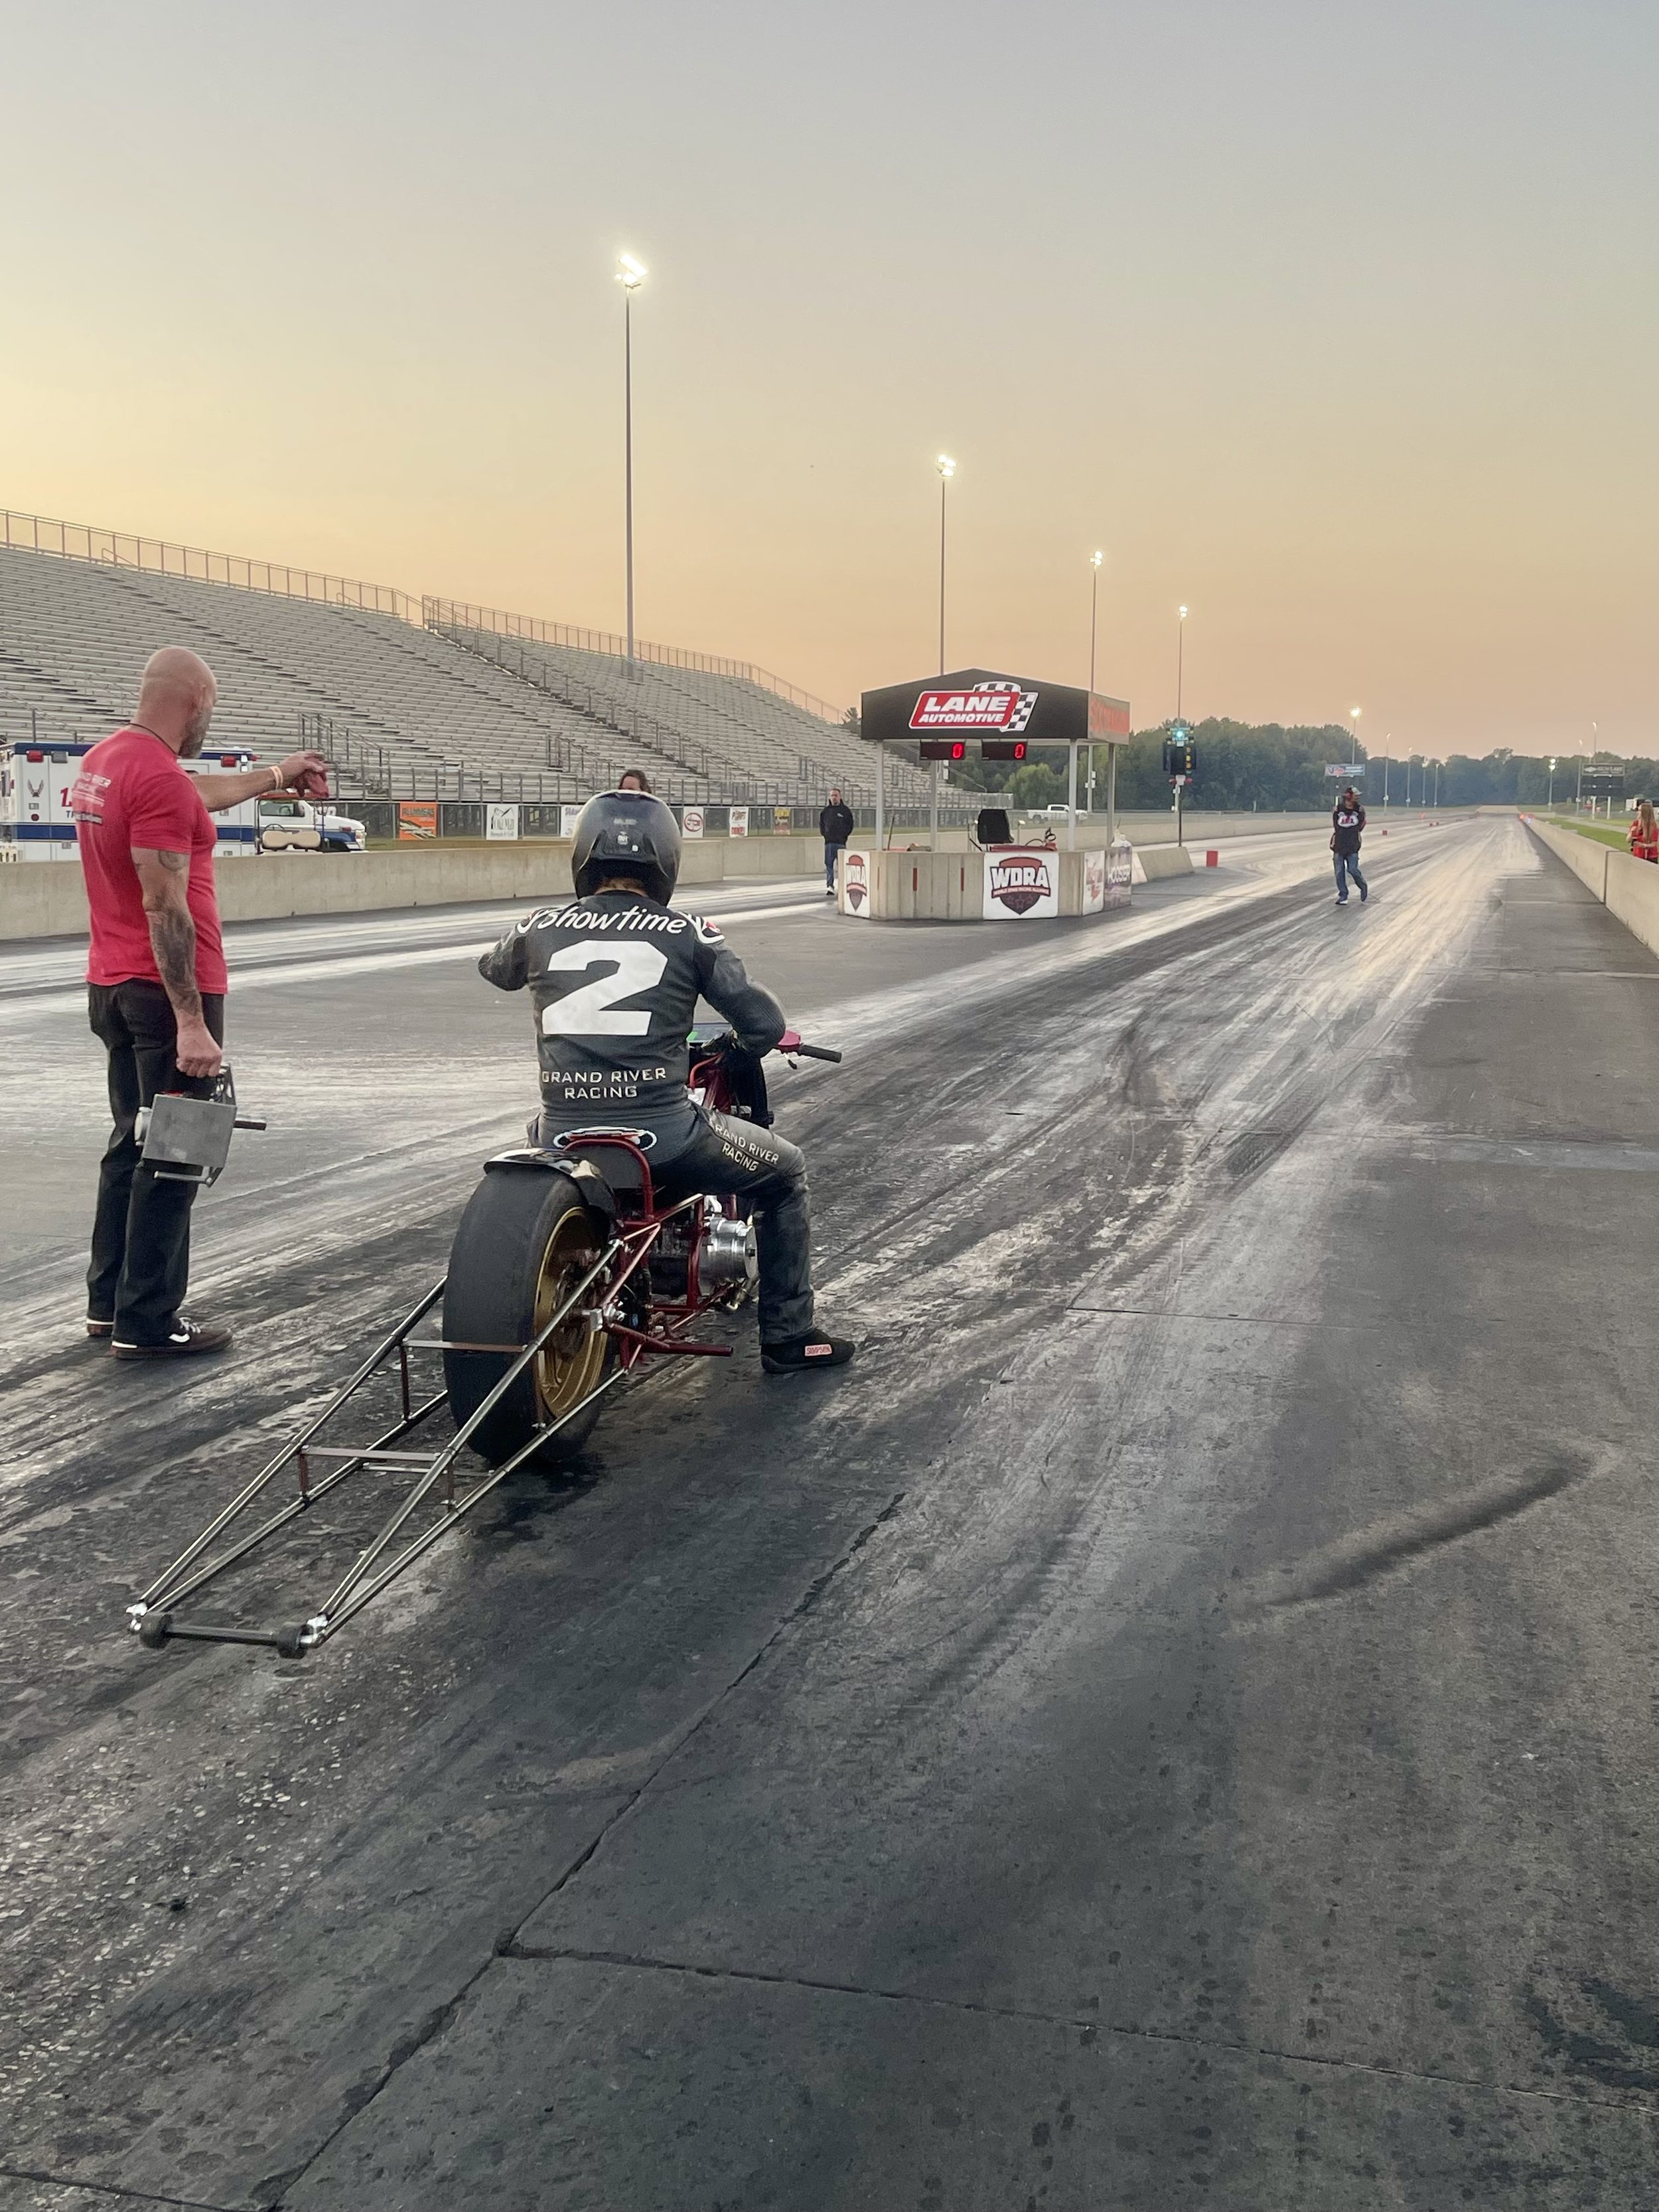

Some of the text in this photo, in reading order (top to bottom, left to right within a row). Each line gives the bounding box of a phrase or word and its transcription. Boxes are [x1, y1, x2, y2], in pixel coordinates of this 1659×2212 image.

[924, 696, 1011, 712] LANE
[918, 713, 1005, 723] AUTOMOTIVE
[952, 743, 963, 759] 0
[1015, 743, 1025, 759] 0
[846, 864, 867, 887] WDRA
[991, 866, 1050, 889] WDRA
[541, 940, 668, 1035] 2
[541, 1067, 666, 1083] GRAND RIVER
[565, 1086, 637, 1099] RACING
[722, 1142, 759, 1171] RACING
[749, 1143, 779, 1165] RIVER
